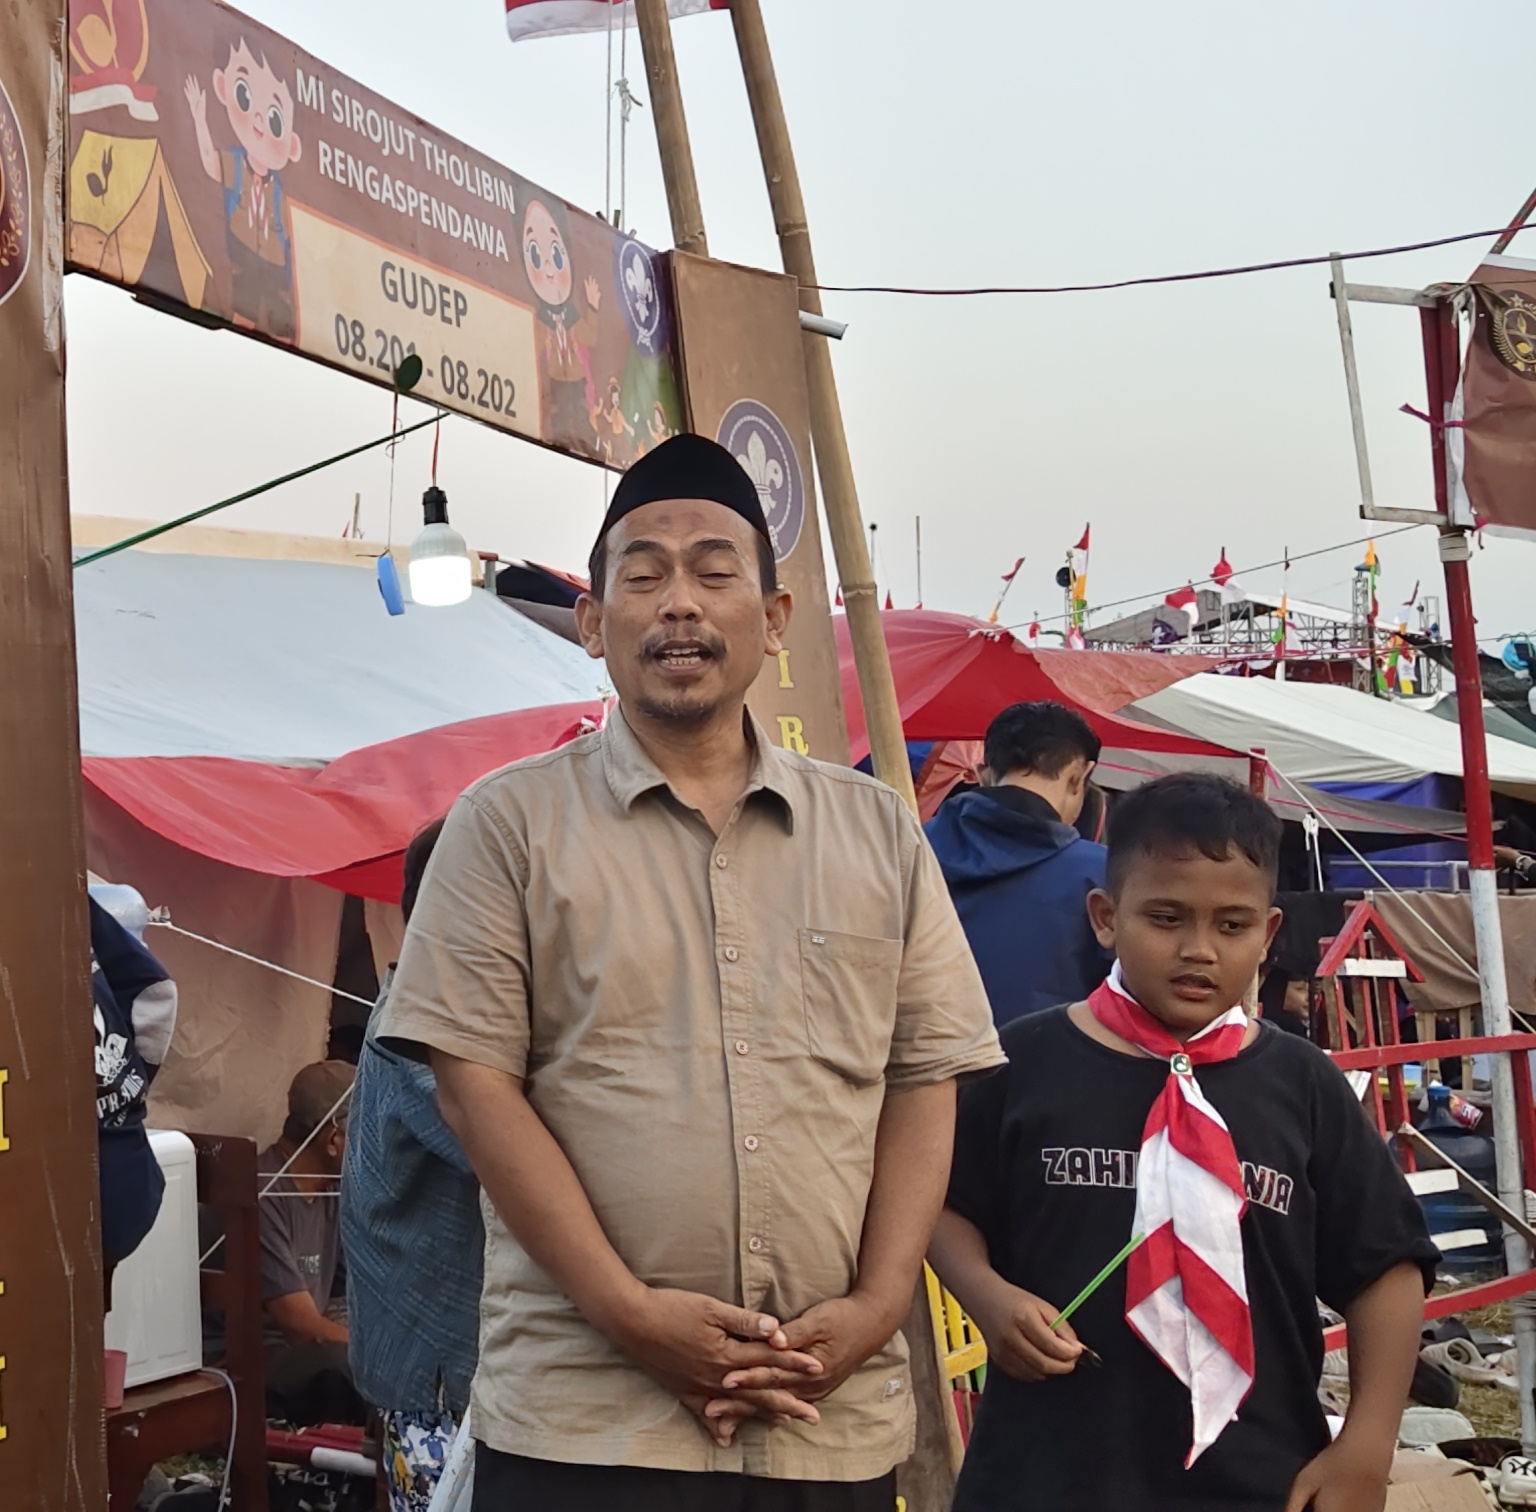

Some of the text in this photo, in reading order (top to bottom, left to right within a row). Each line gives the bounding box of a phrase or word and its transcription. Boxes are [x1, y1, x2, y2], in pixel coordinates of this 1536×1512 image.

[296, 67, 516, 214] MI SIROJUT THOLIBIN
[318, 140, 510, 263] RENGASPENDAWA
[381, 261, 468, 328] GUDEP
[440, 354, 517, 418] 08.202
[1041, 1147, 1294, 1216] ZAHI NIA
